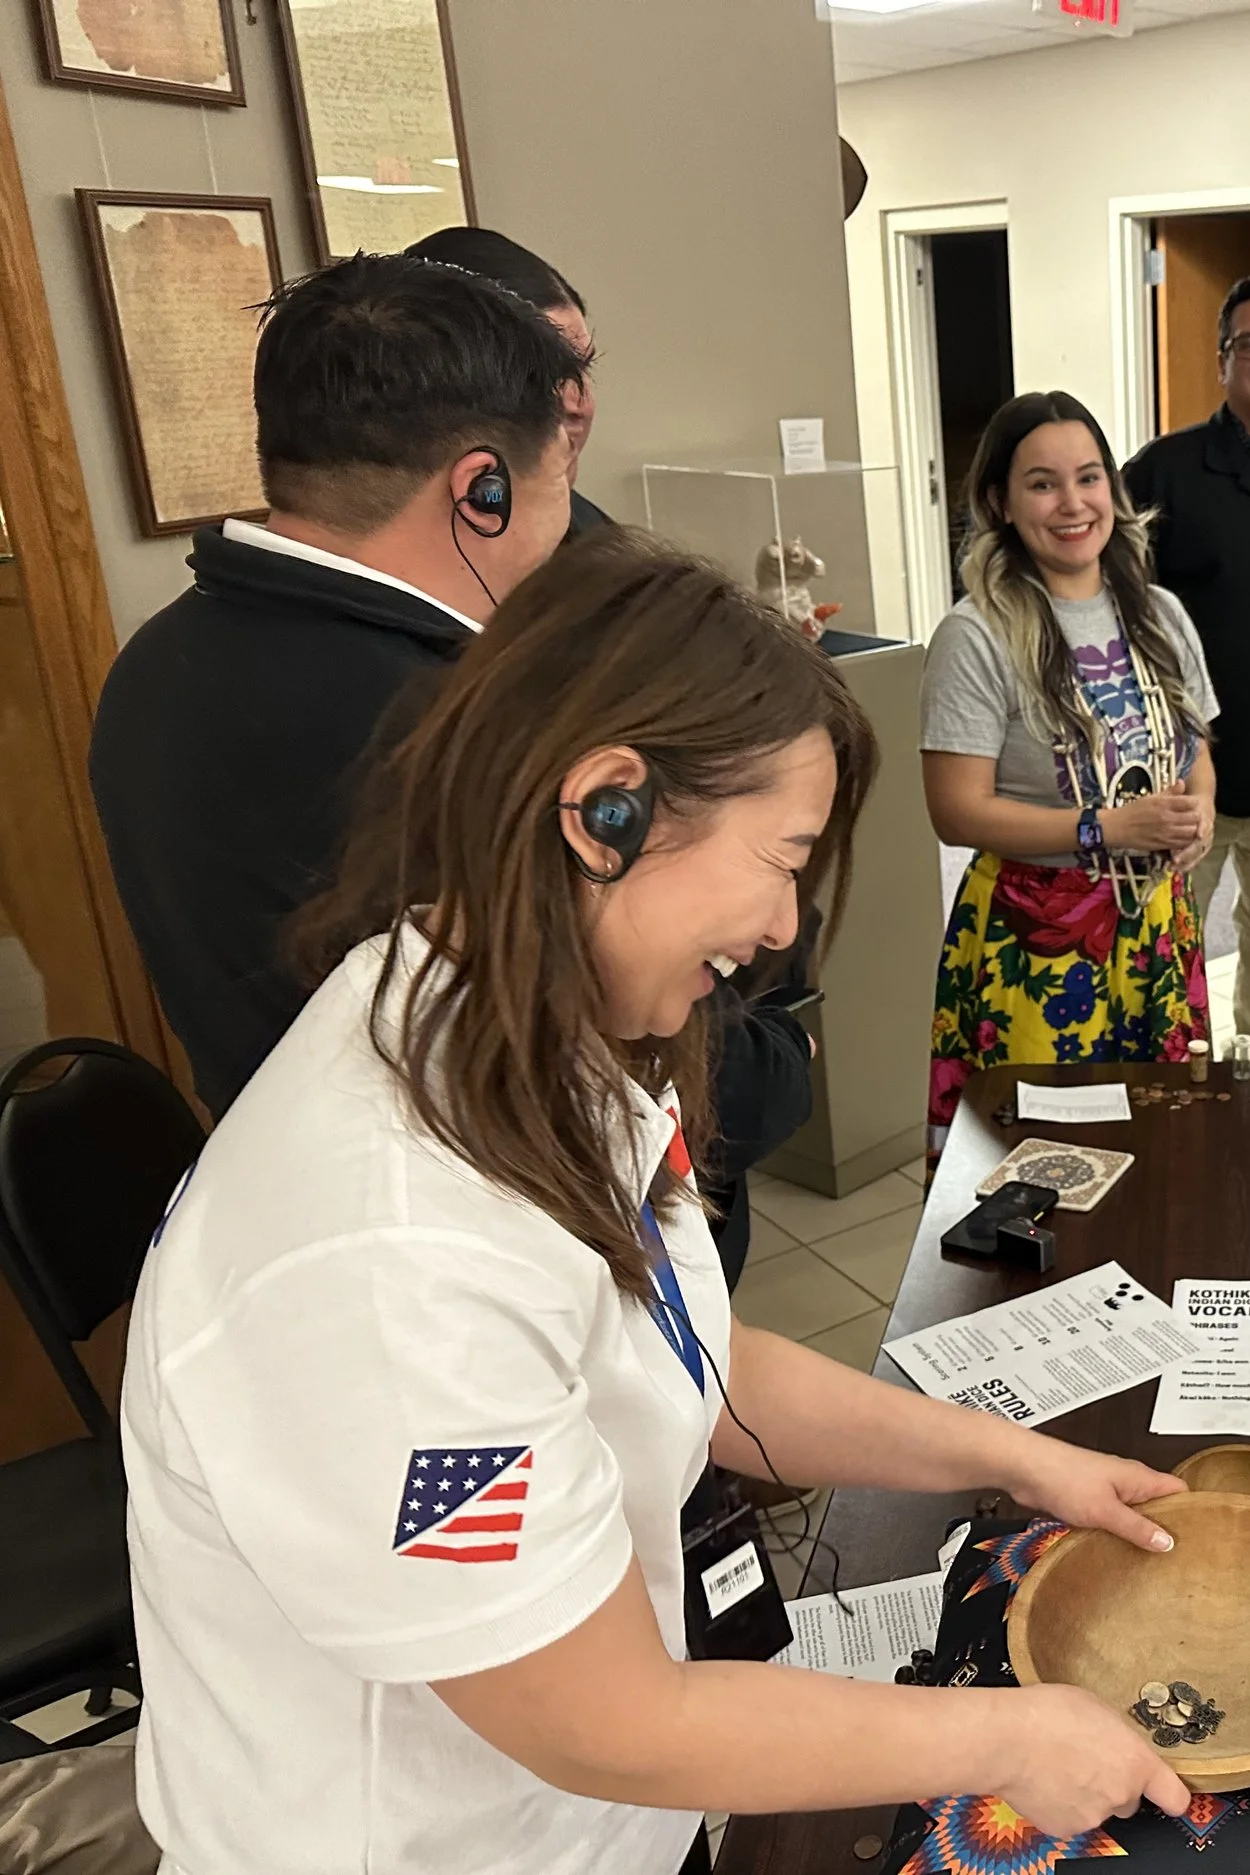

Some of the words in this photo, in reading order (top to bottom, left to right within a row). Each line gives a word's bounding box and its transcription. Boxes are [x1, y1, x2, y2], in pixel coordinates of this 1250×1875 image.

[484, 490, 503, 503] VOX
[966, 1384, 989, 1405] DICE
[981, 1378, 1036, 1421] RULES
